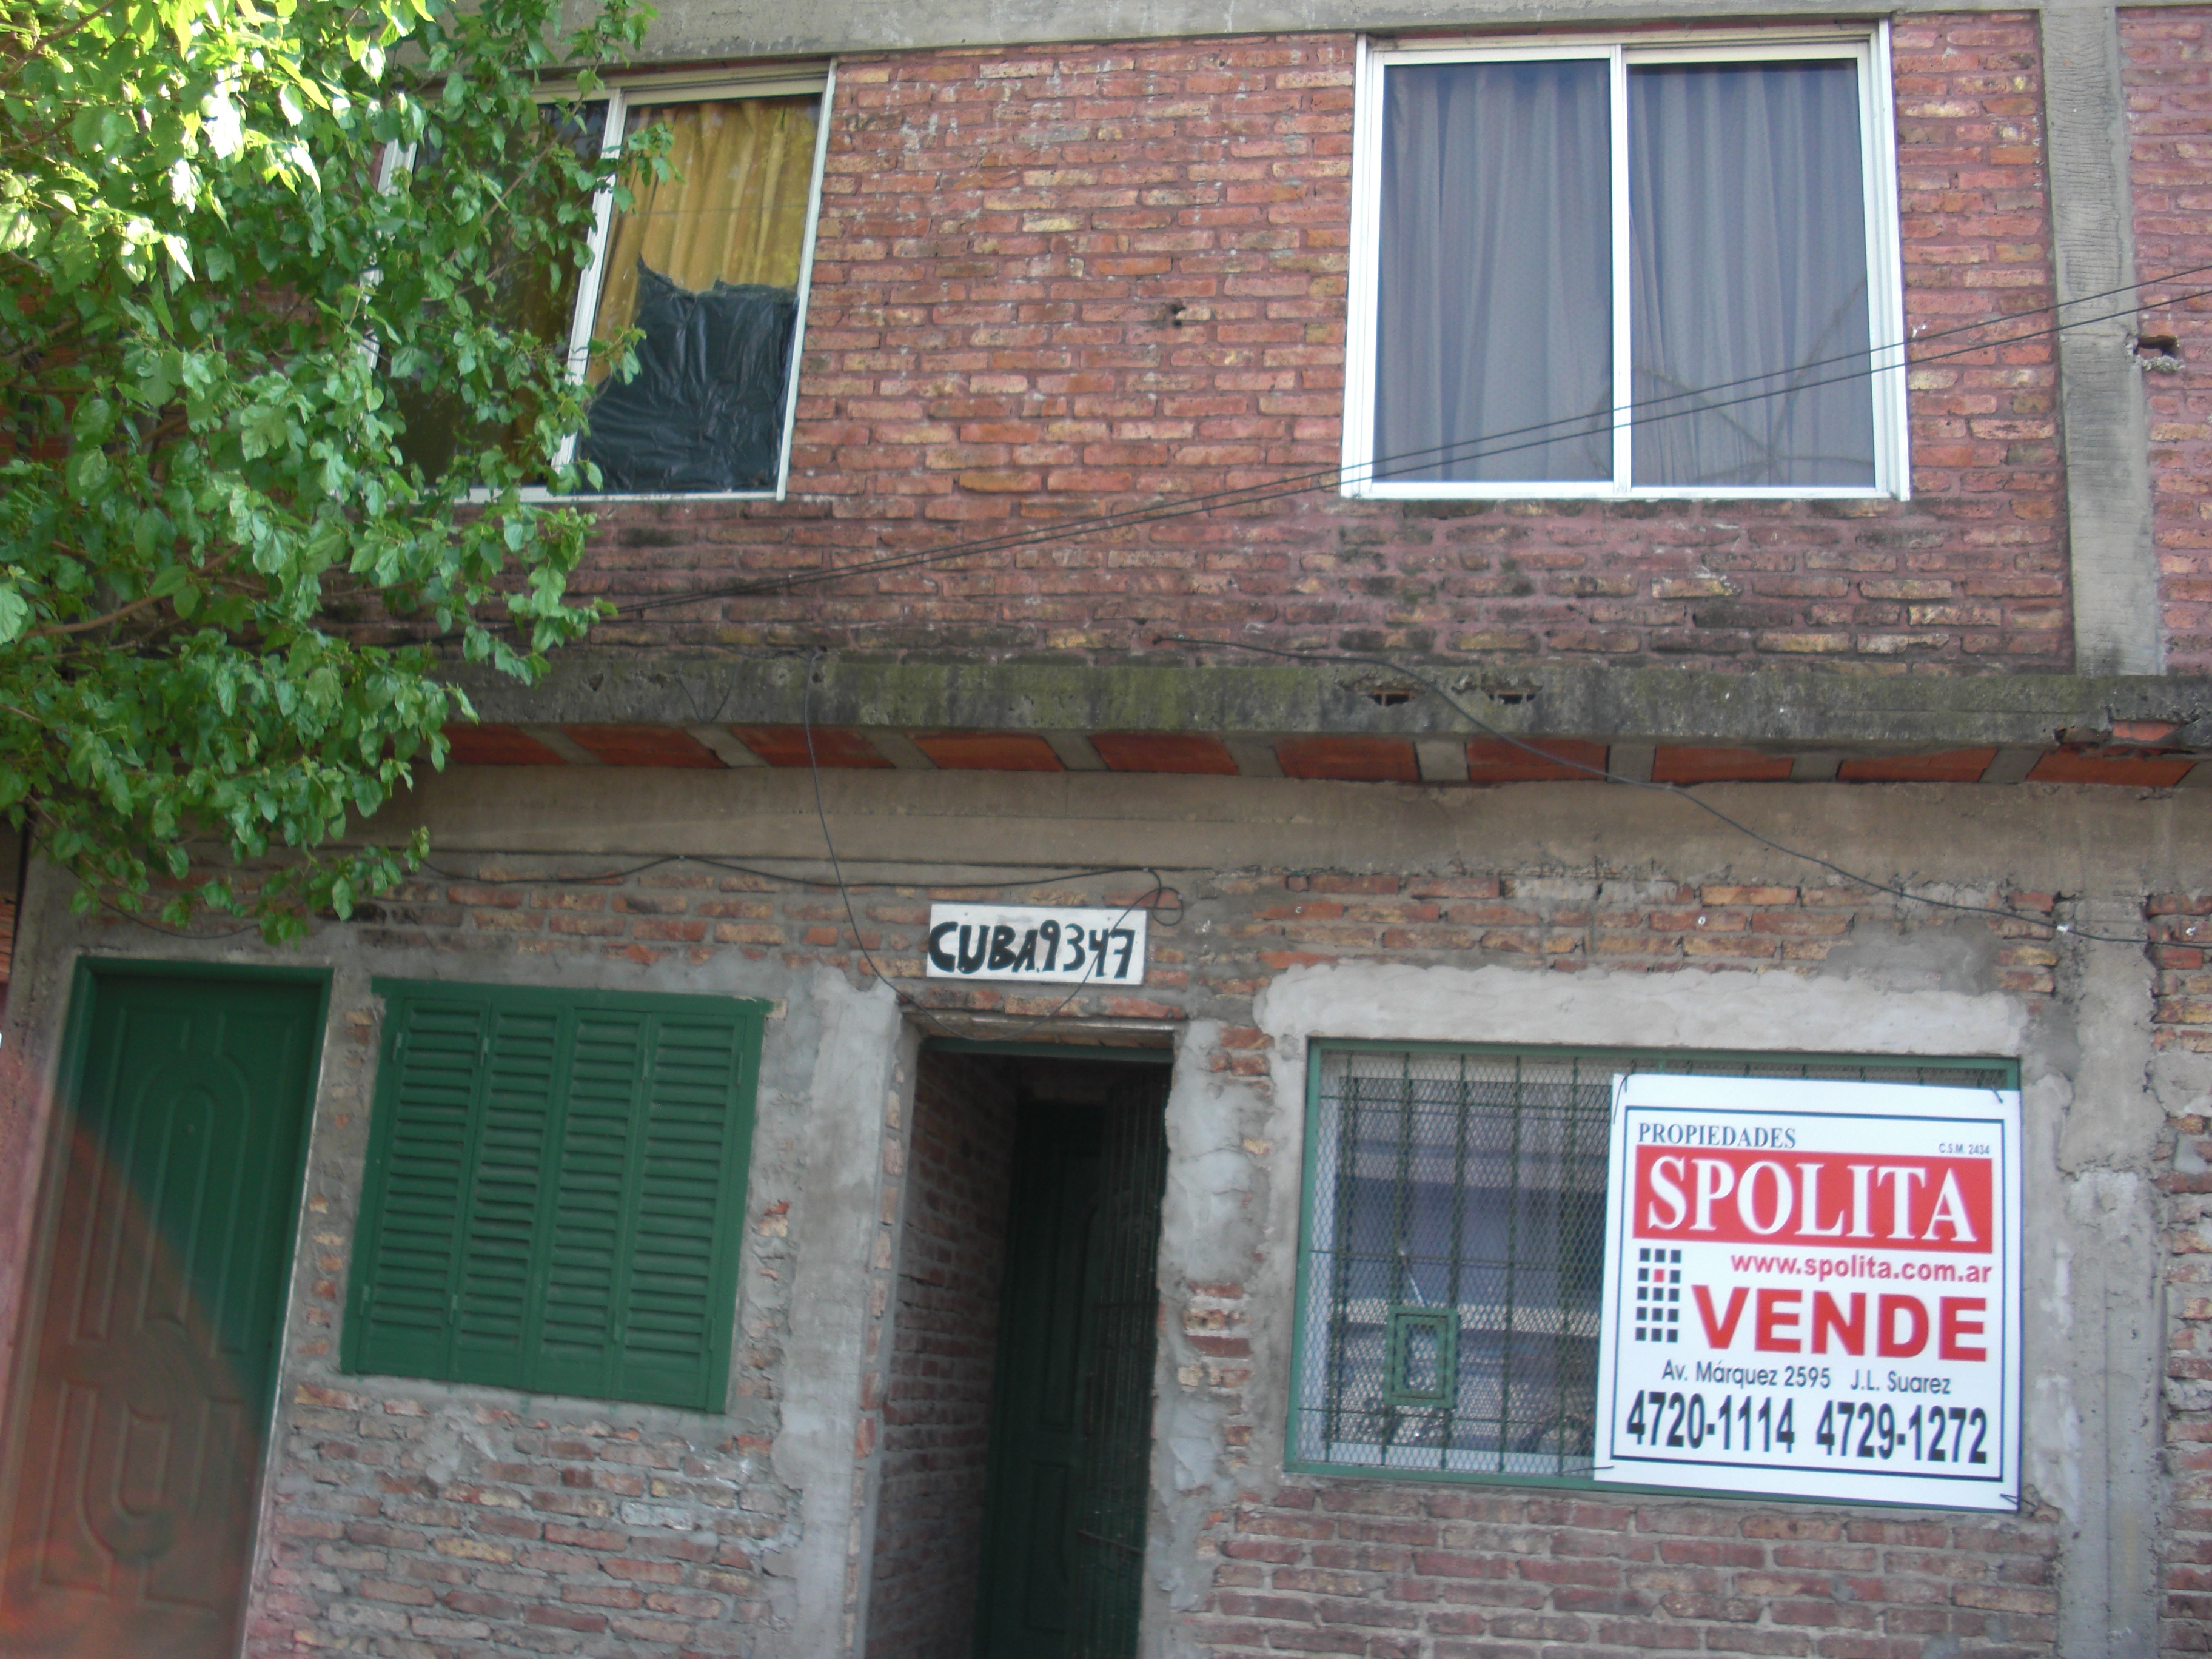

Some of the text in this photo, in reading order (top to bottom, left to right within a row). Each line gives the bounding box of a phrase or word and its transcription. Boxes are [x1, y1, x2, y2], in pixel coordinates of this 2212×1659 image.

[1638, 1122, 1796, 1149] PROPIEDADES
[1647, 1155, 1977, 1243] SPOLITA
[1731, 1253, 1993, 1283] www.spolita.com.ar
[1691, 1284, 1987, 1362] VENDE
[1662, 1360, 1951, 1395] Av. Márquez 2595 J.L. Suarez
[1626, 1390, 1988, 1465] 4720-1114 4729-1272
